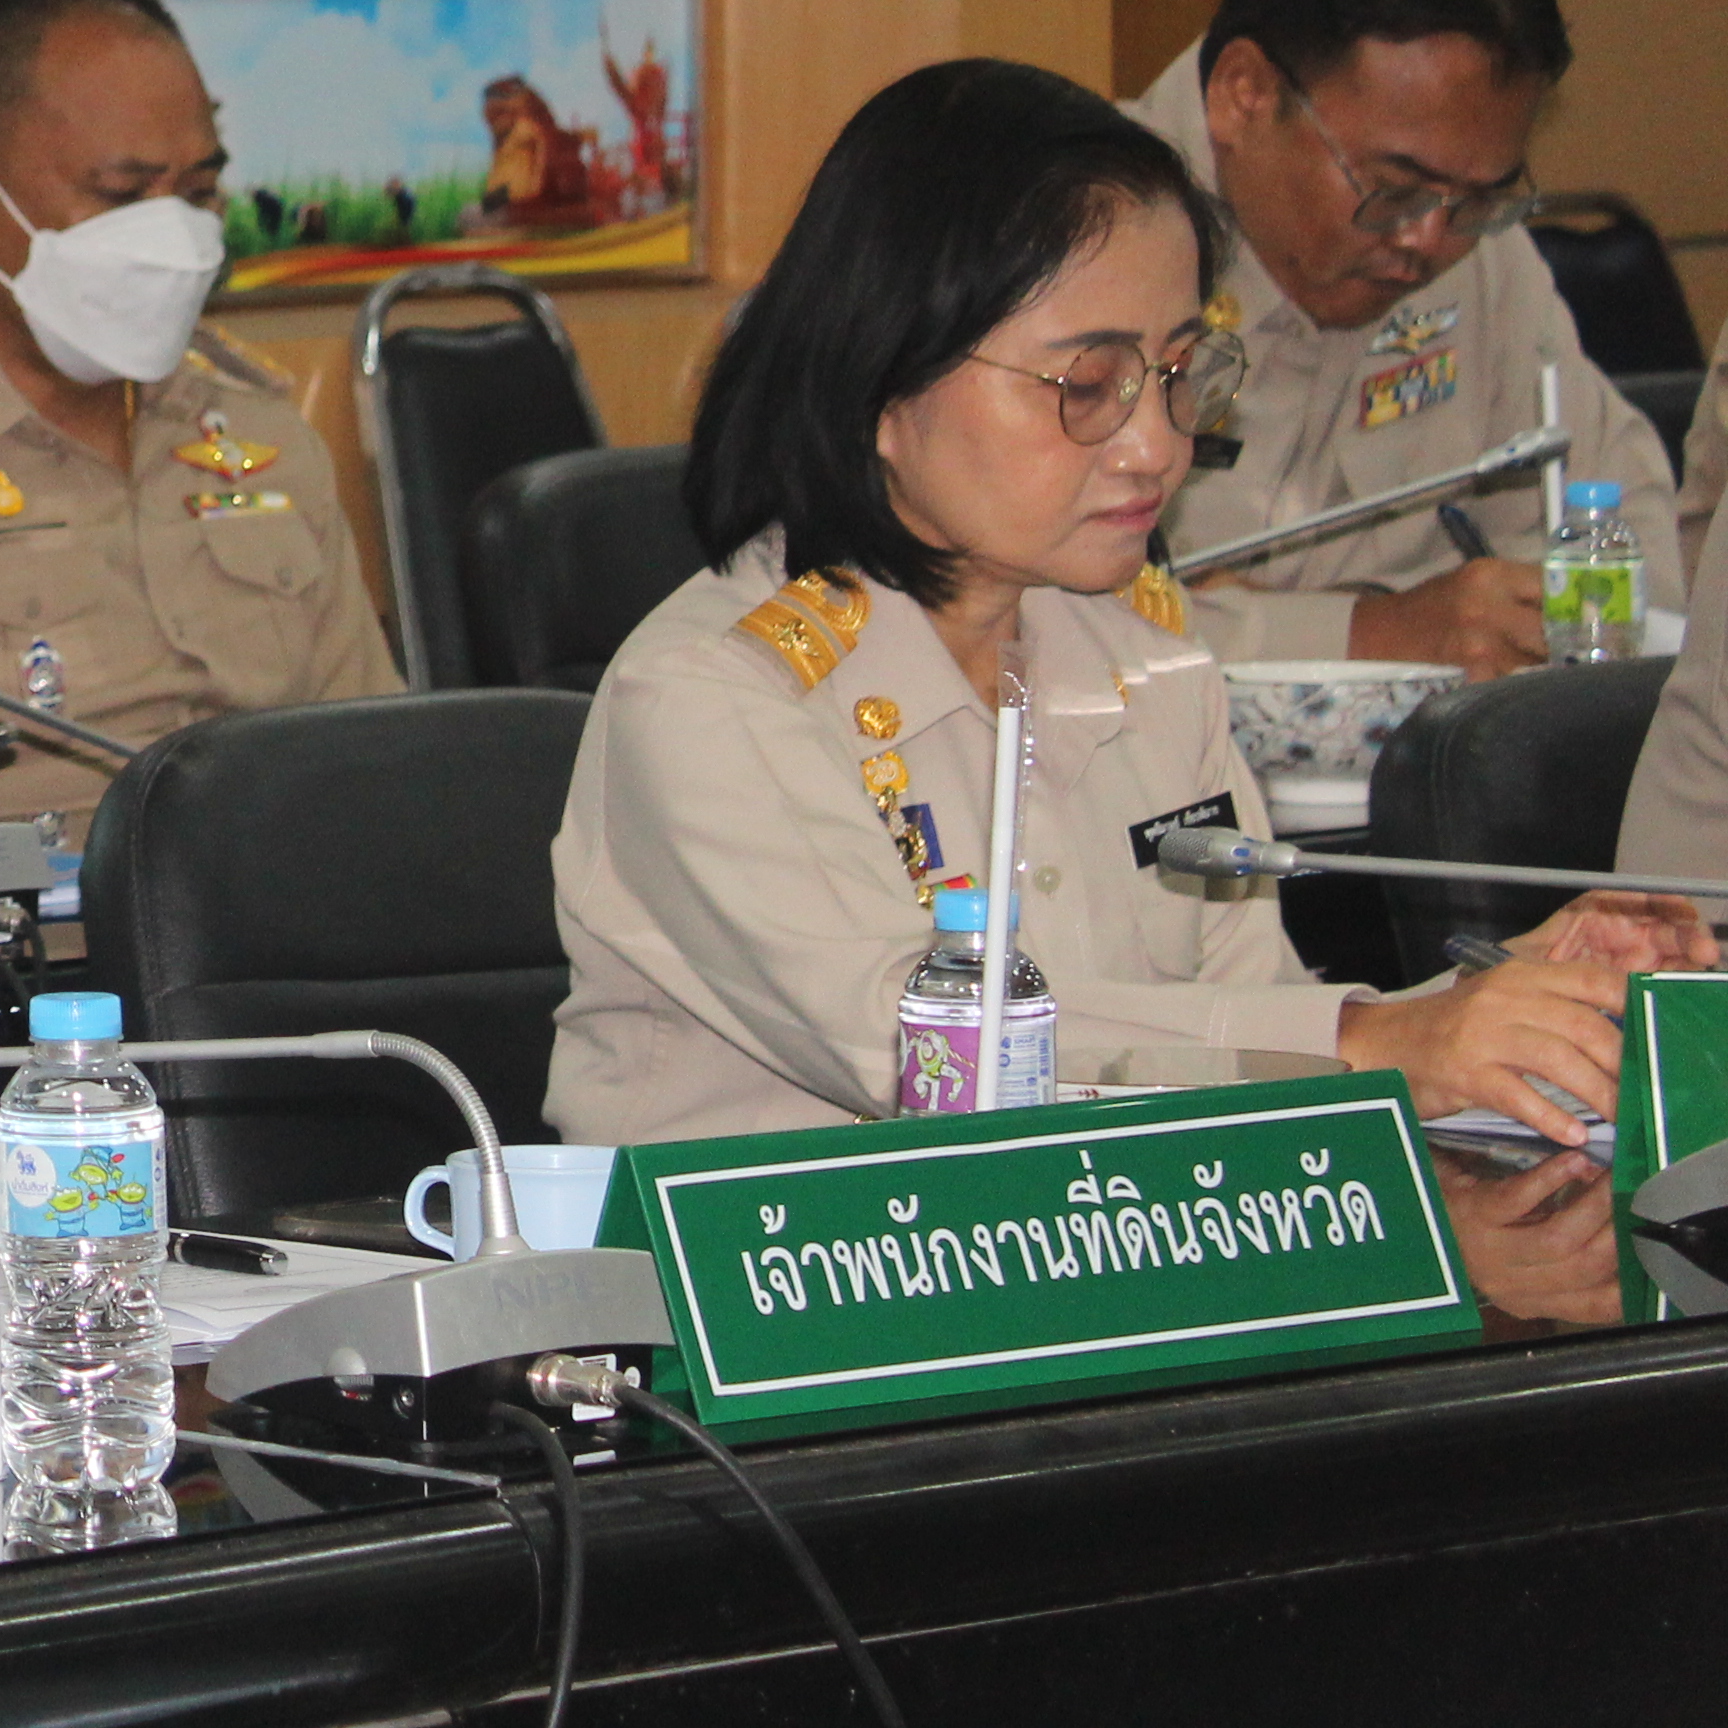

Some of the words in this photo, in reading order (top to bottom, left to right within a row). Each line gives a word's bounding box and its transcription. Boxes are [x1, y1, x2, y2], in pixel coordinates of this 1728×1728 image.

[741, 1148, 1385, 1315] เจ้าพนักงานที่ดินจังหวัด
